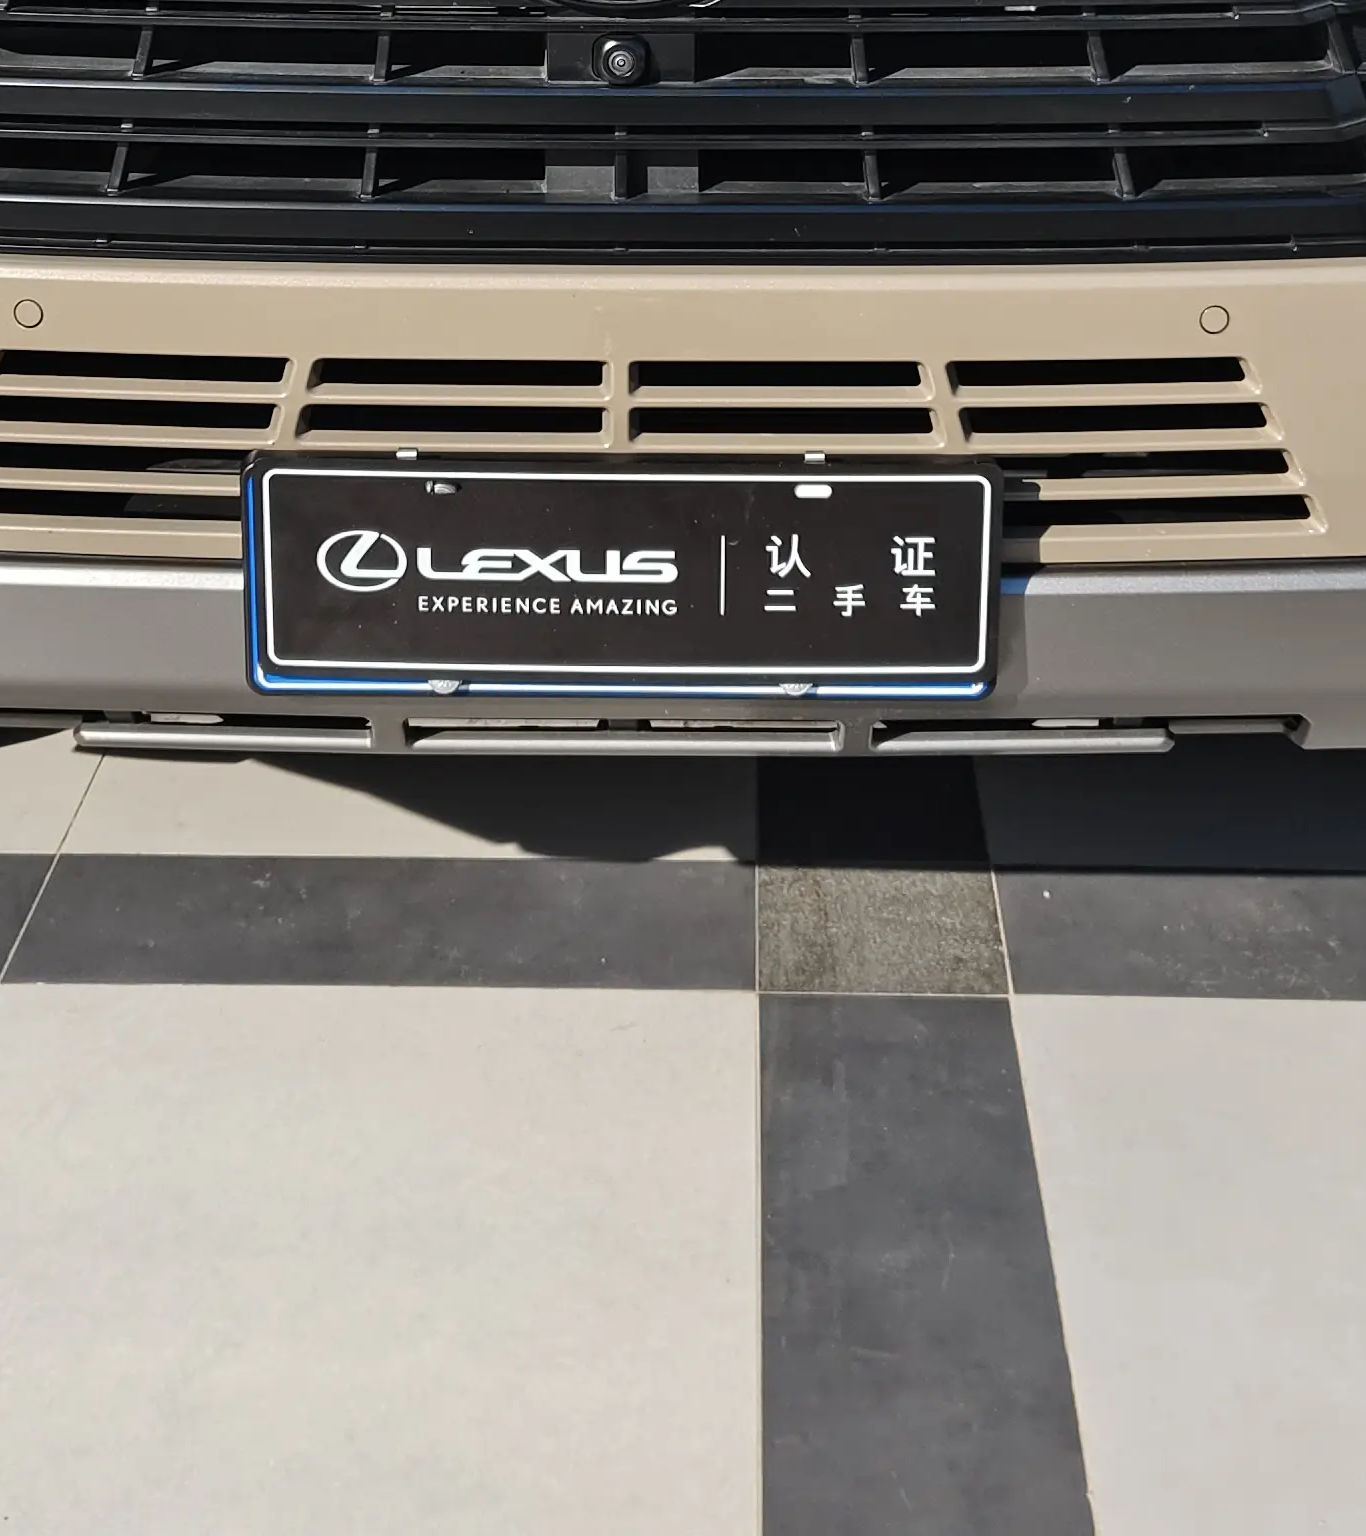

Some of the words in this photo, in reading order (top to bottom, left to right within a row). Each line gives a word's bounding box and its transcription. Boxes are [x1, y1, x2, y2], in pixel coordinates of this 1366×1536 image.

[417, 547, 679, 584] LEXUS
[766, 534, 936, 578] 认证
[418, 595, 561, 615] EXPERIENCE
[570, 598, 678, 616] AMAZING
[764, 583, 936, 617] 二手车
